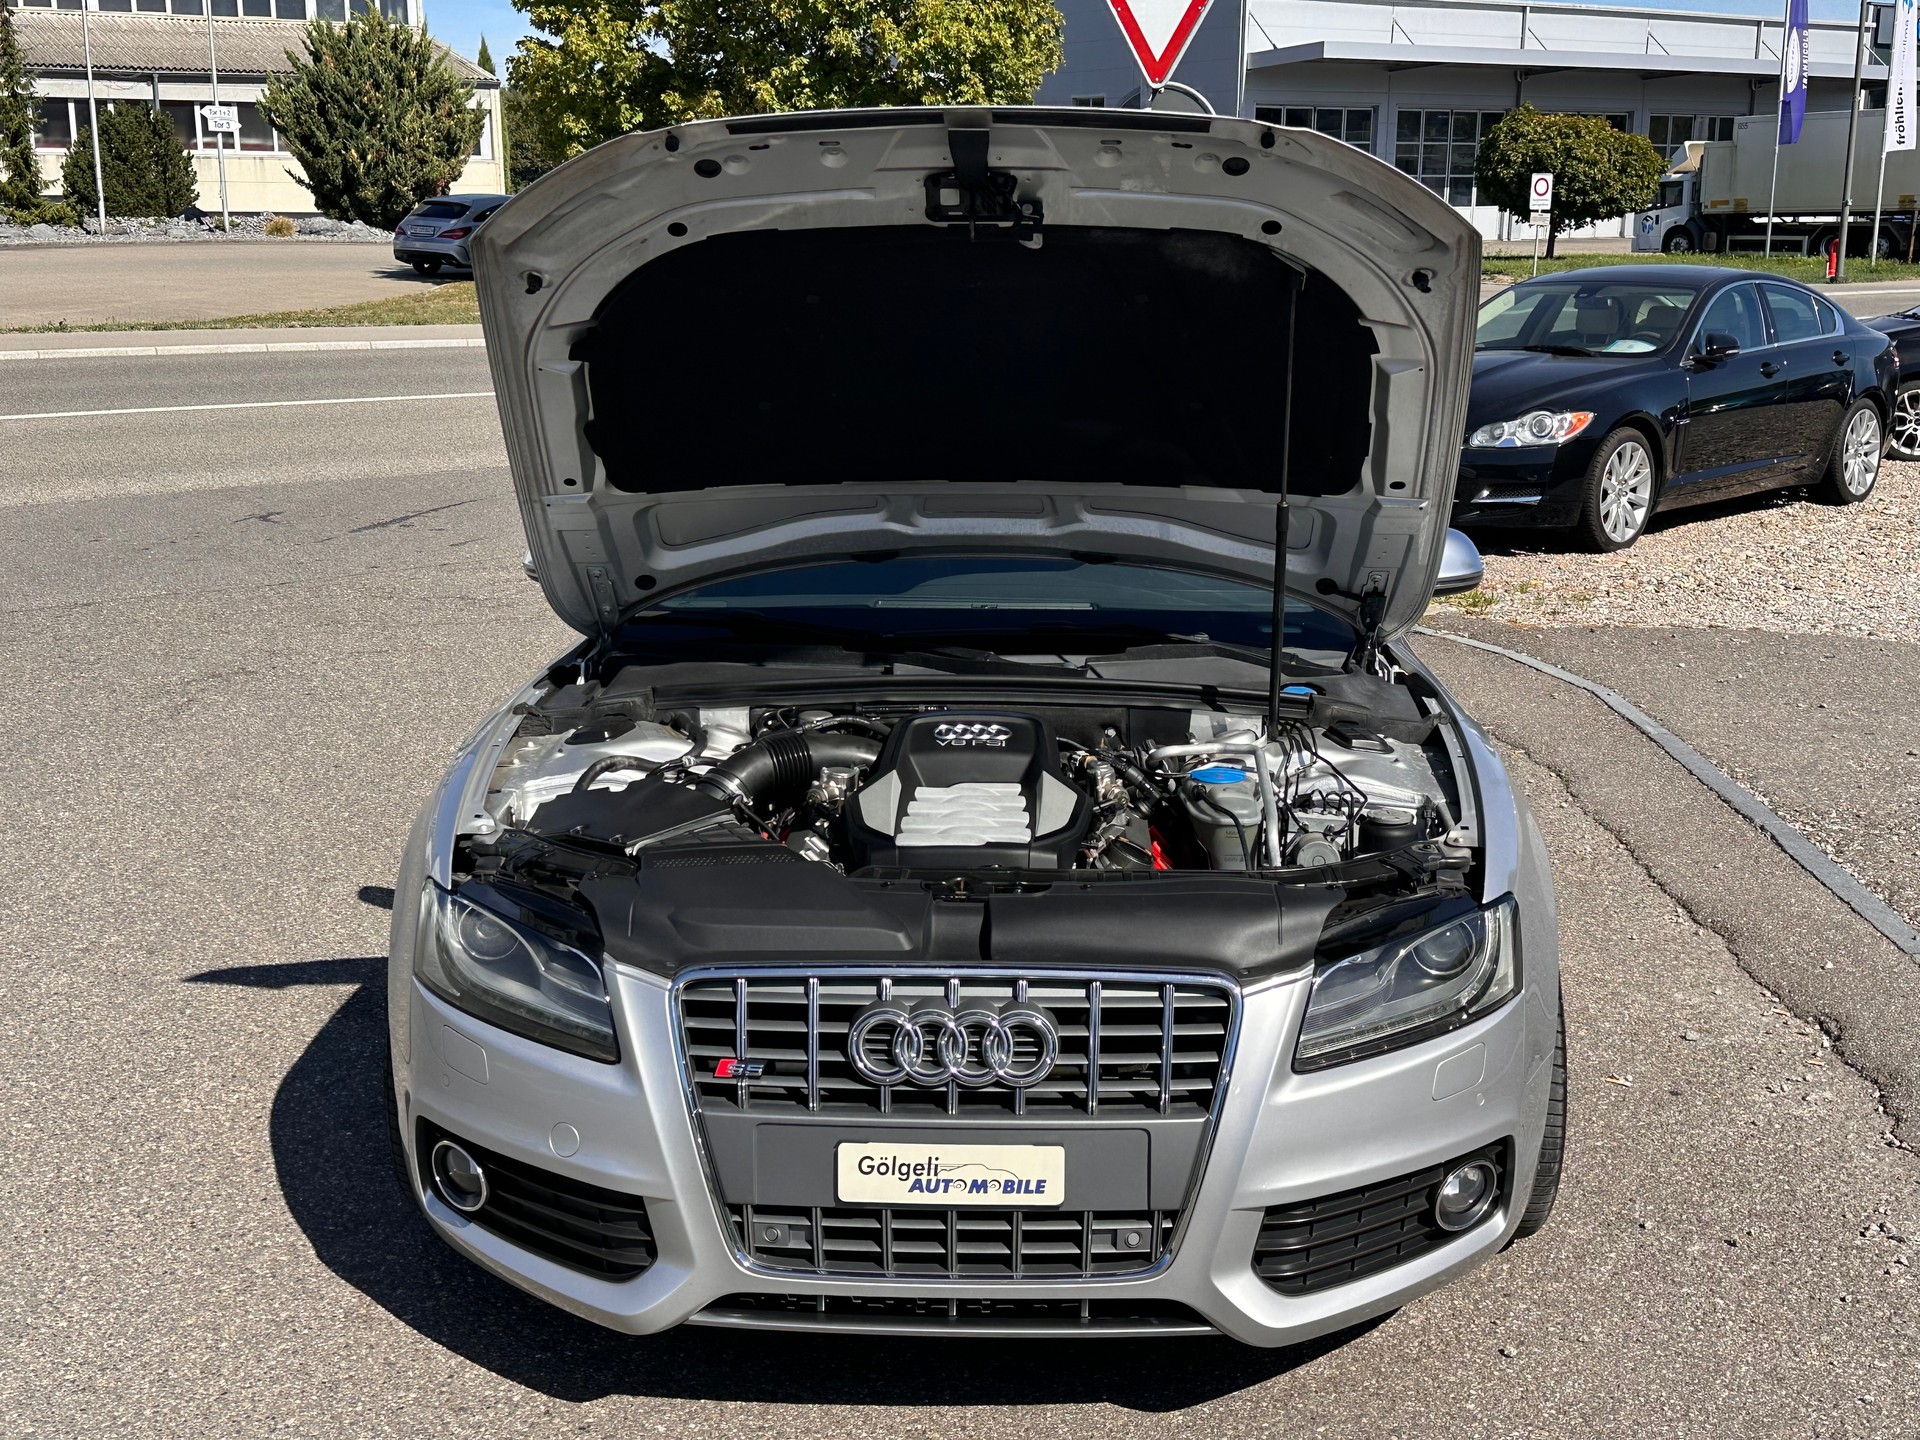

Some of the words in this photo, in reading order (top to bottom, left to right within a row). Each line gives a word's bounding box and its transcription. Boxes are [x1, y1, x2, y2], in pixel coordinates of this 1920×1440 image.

[209, 108, 218, 116] Tor
[213, 120, 224, 129] Tor
[225, 121, 231, 129] 3
[972, 739, 1006, 747] FSI
[727, 1063, 765, 1076] S5
[857, 1155, 940, 1182] Gölgeli
[907, 1178, 1047, 1195] AUTOMOBILE
